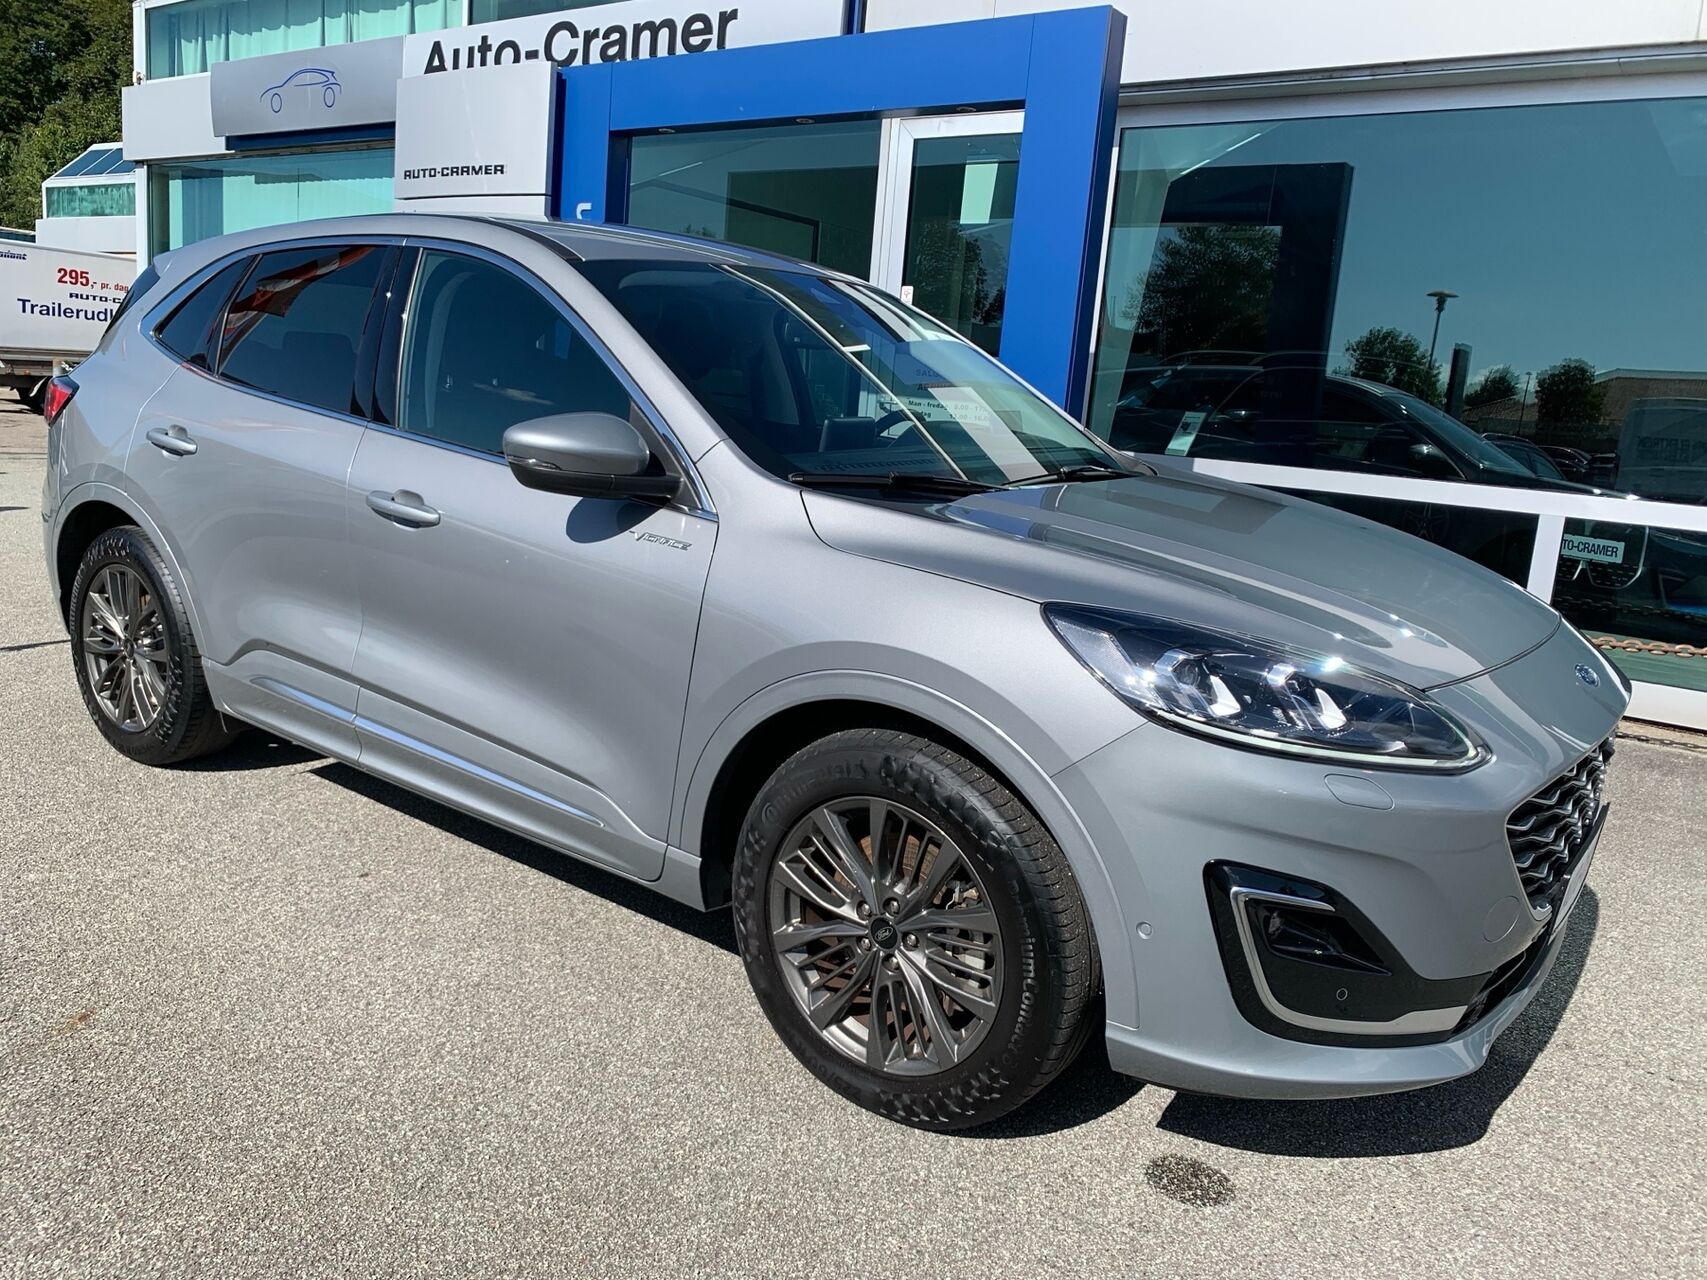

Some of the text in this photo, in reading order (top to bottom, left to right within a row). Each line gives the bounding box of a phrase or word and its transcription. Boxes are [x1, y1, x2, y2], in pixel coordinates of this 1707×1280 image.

[423, 8, 739, 75] Auto-Cramer
[100, 282, 112, 290] pr.
[113, 282, 129, 294] dag
